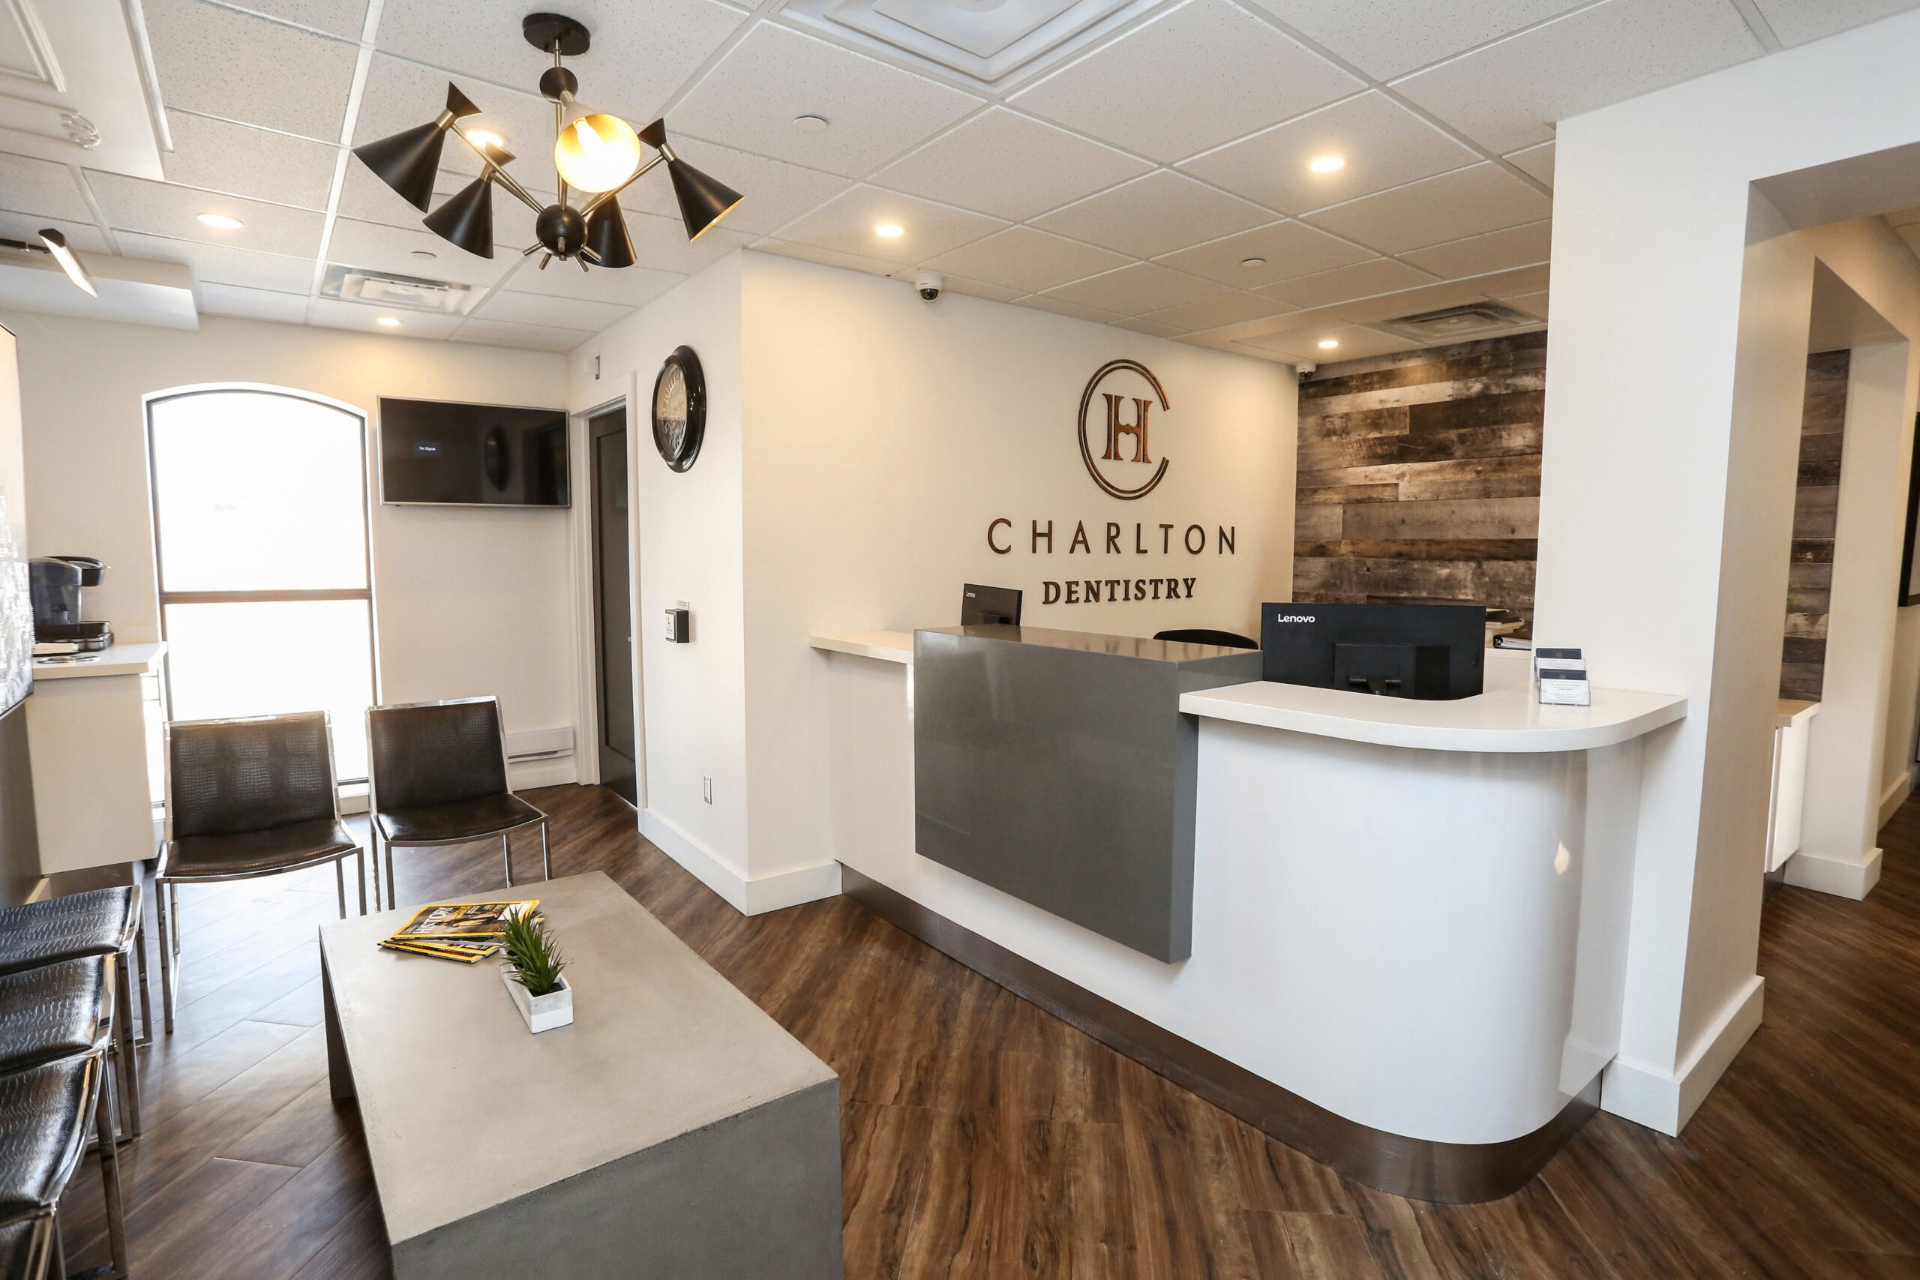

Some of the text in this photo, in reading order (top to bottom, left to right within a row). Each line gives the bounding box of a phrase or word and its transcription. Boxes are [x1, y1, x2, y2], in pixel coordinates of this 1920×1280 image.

[987, 518, 1235, 555] CHARLTON
[1042, 577, 1197, 604] DENTISTRY
[1278, 613, 1316, 623] Lenovo
